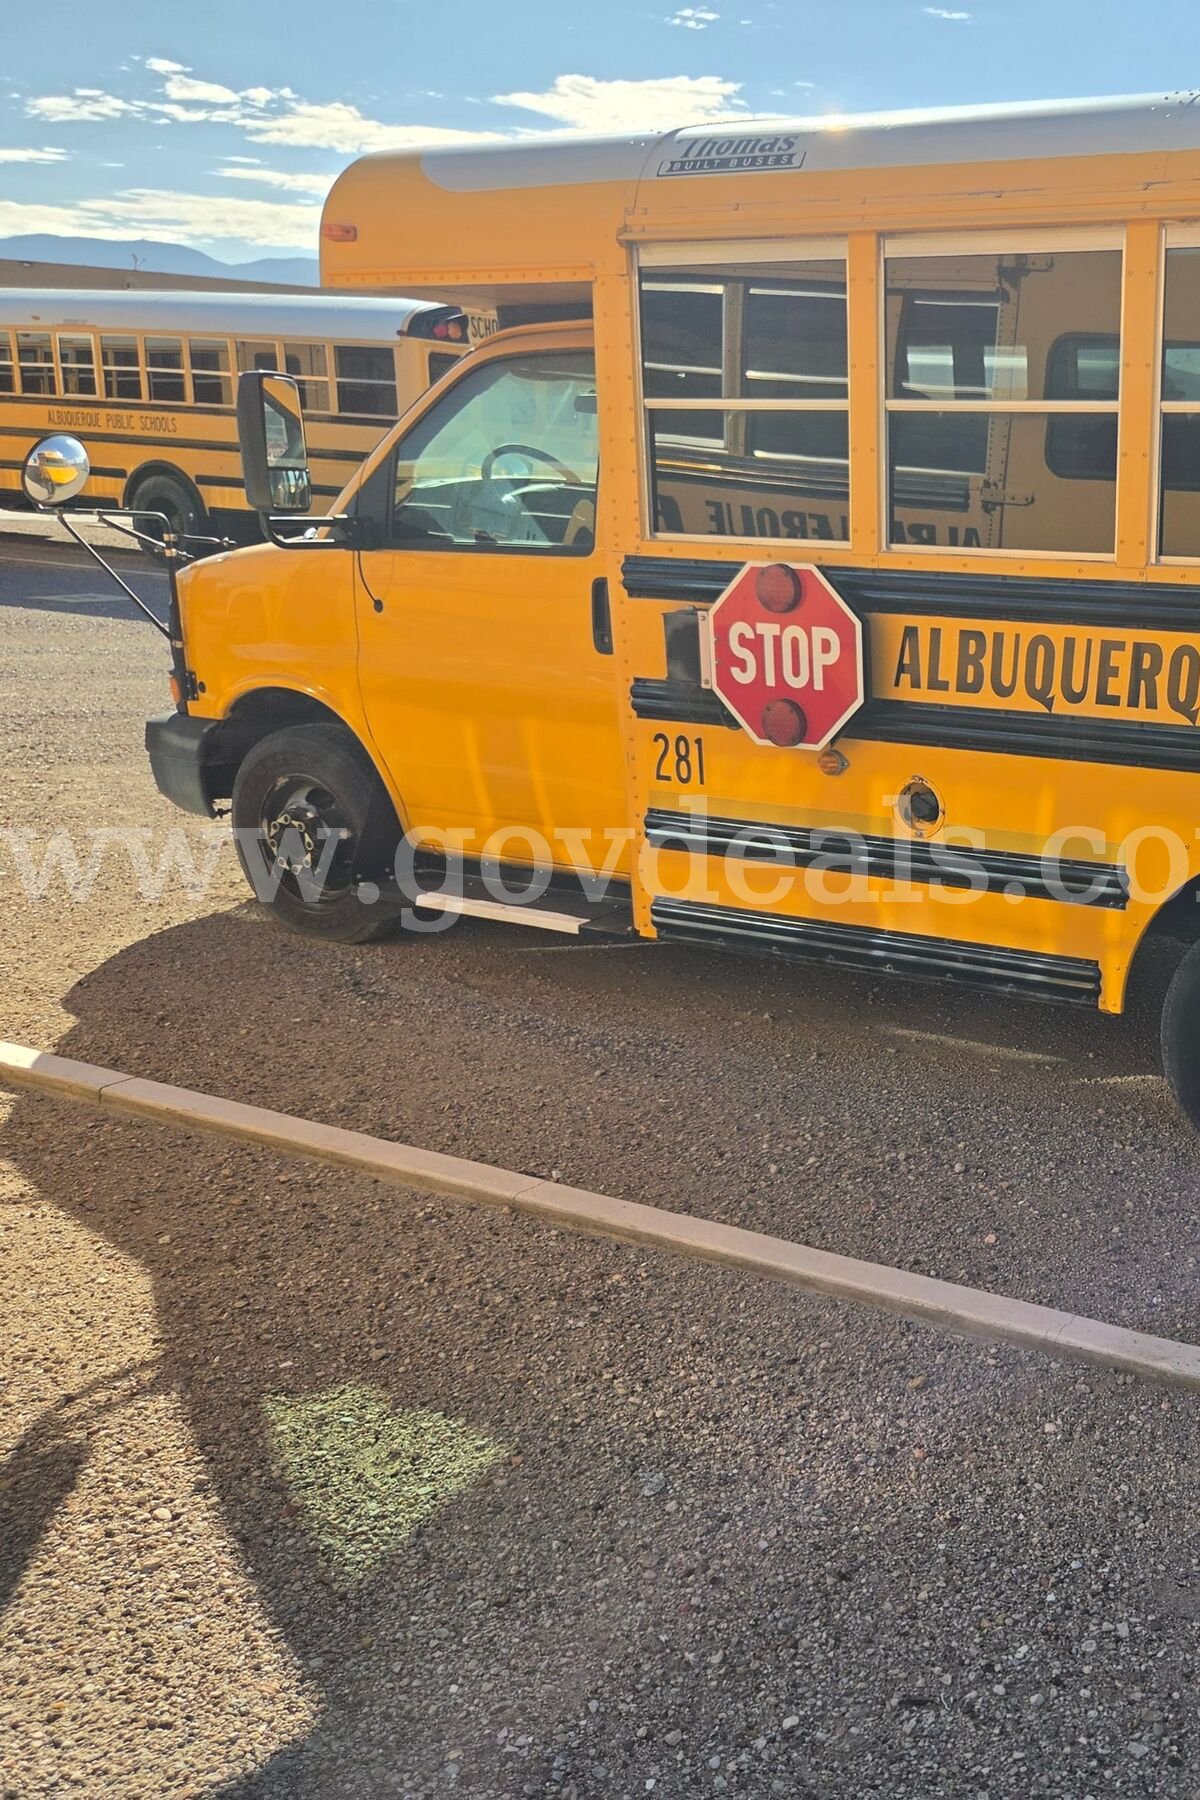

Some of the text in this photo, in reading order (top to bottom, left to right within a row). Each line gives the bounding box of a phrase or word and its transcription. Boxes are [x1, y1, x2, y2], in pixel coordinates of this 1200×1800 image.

[676, 135, 799, 159] Thomas
[672, 155, 790, 171] BUILT BUSES
[48, 410, 177, 433] ALBUQUERQUE PUBLIC SCHOOLS
[728, 621, 841, 691] STOP
[653, 732, 705, 785] 281
